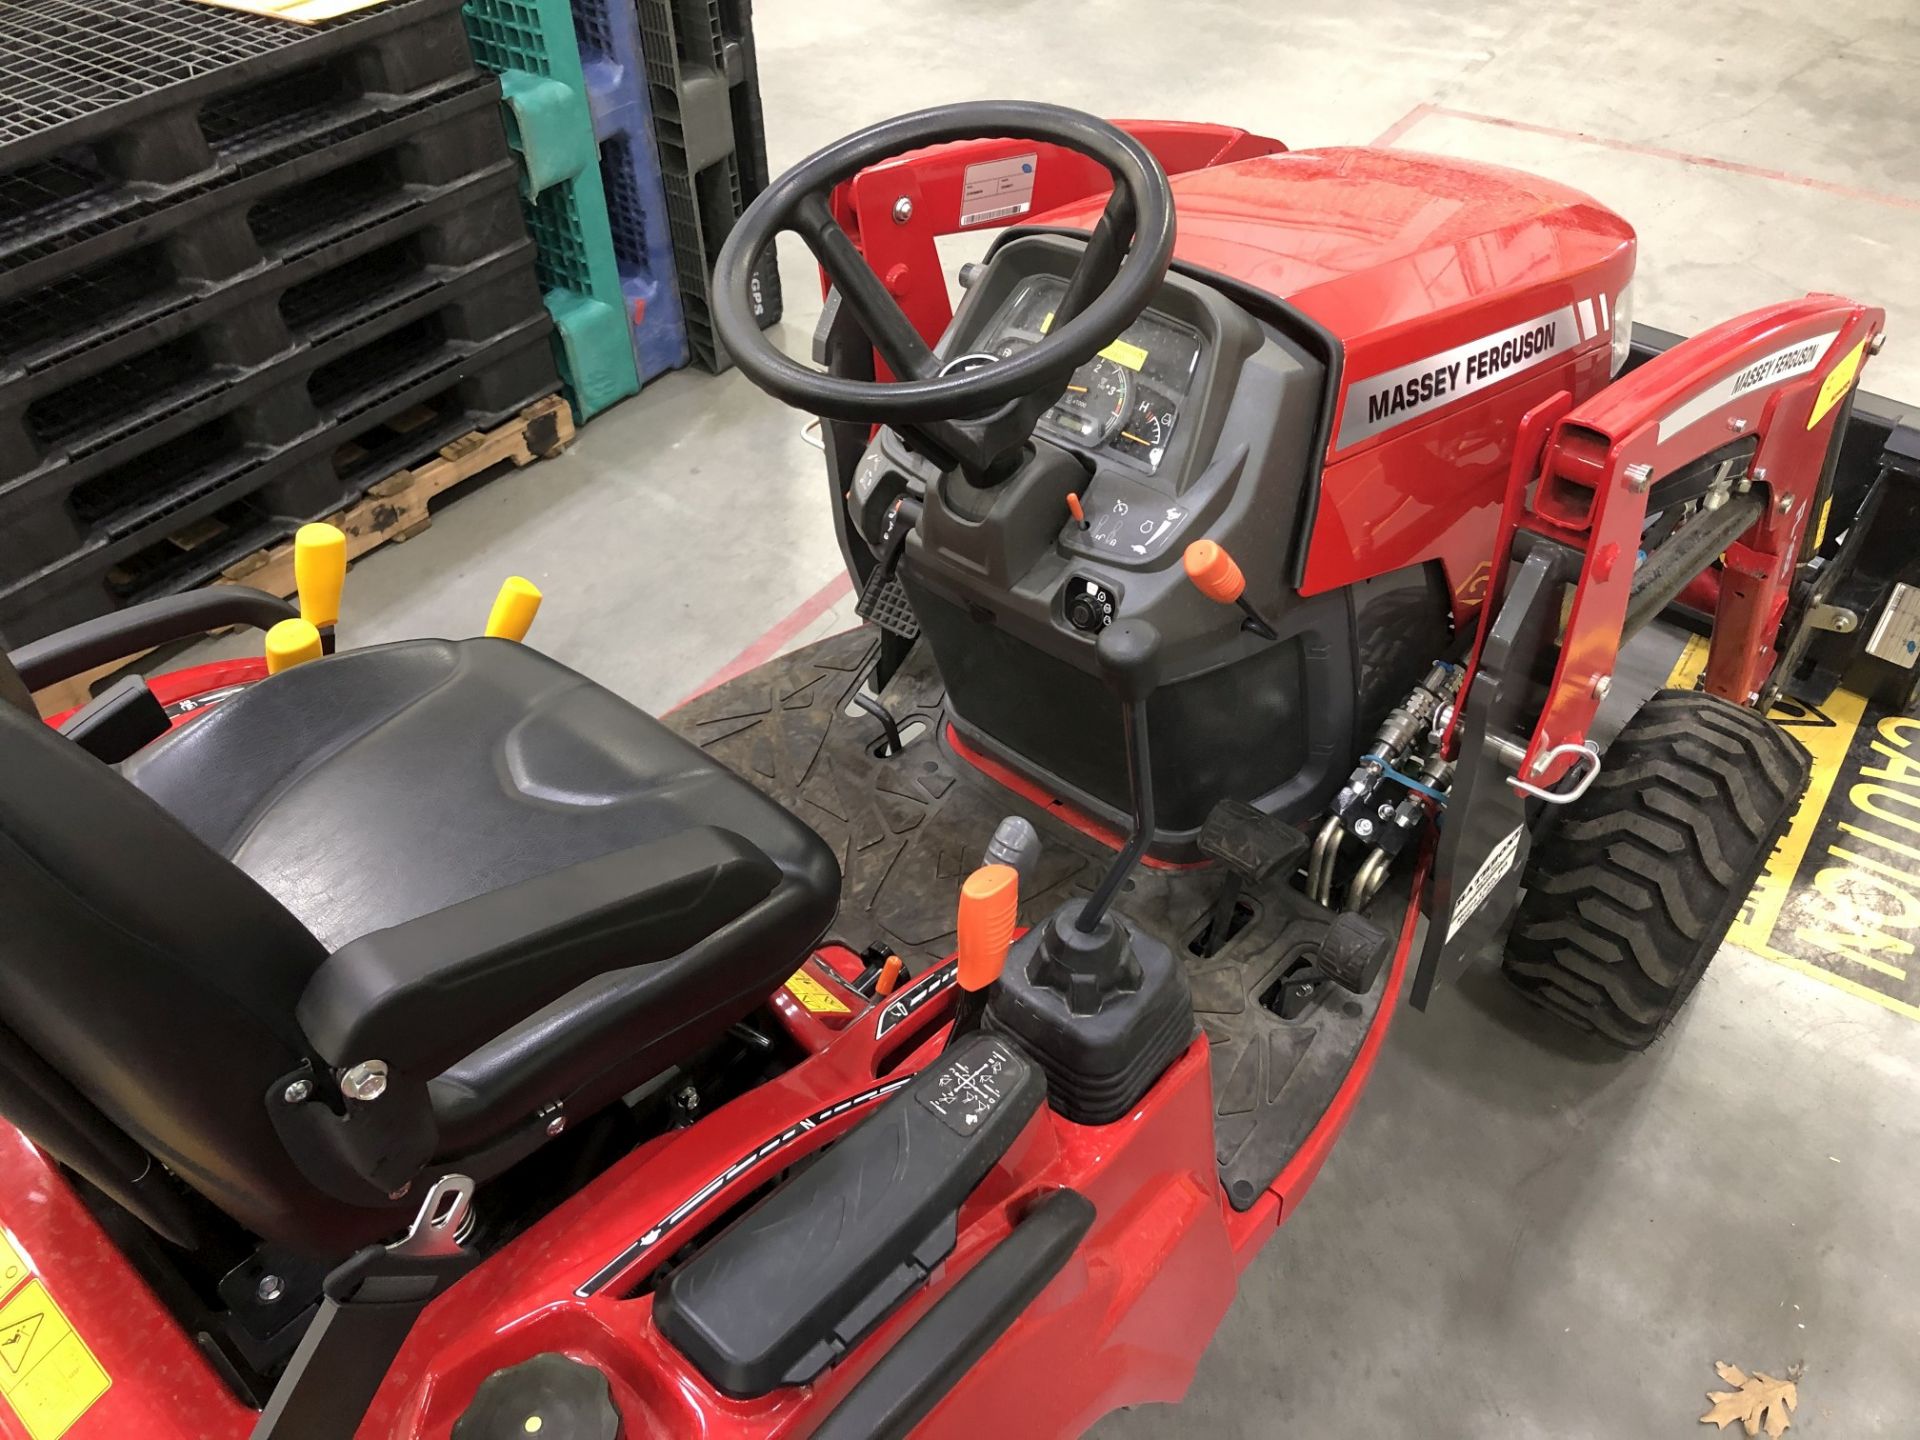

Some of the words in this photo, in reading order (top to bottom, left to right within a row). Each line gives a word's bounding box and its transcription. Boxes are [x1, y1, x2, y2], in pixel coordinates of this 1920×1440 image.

[1369, 361, 1461, 424] MASSEY
[1466, 321, 1556, 385] FERGUSON
[1730, 358, 1776, 396] MASSEY
[1771, 343, 1820, 376] FERGUSON
[799, 1118, 817, 1131] N
